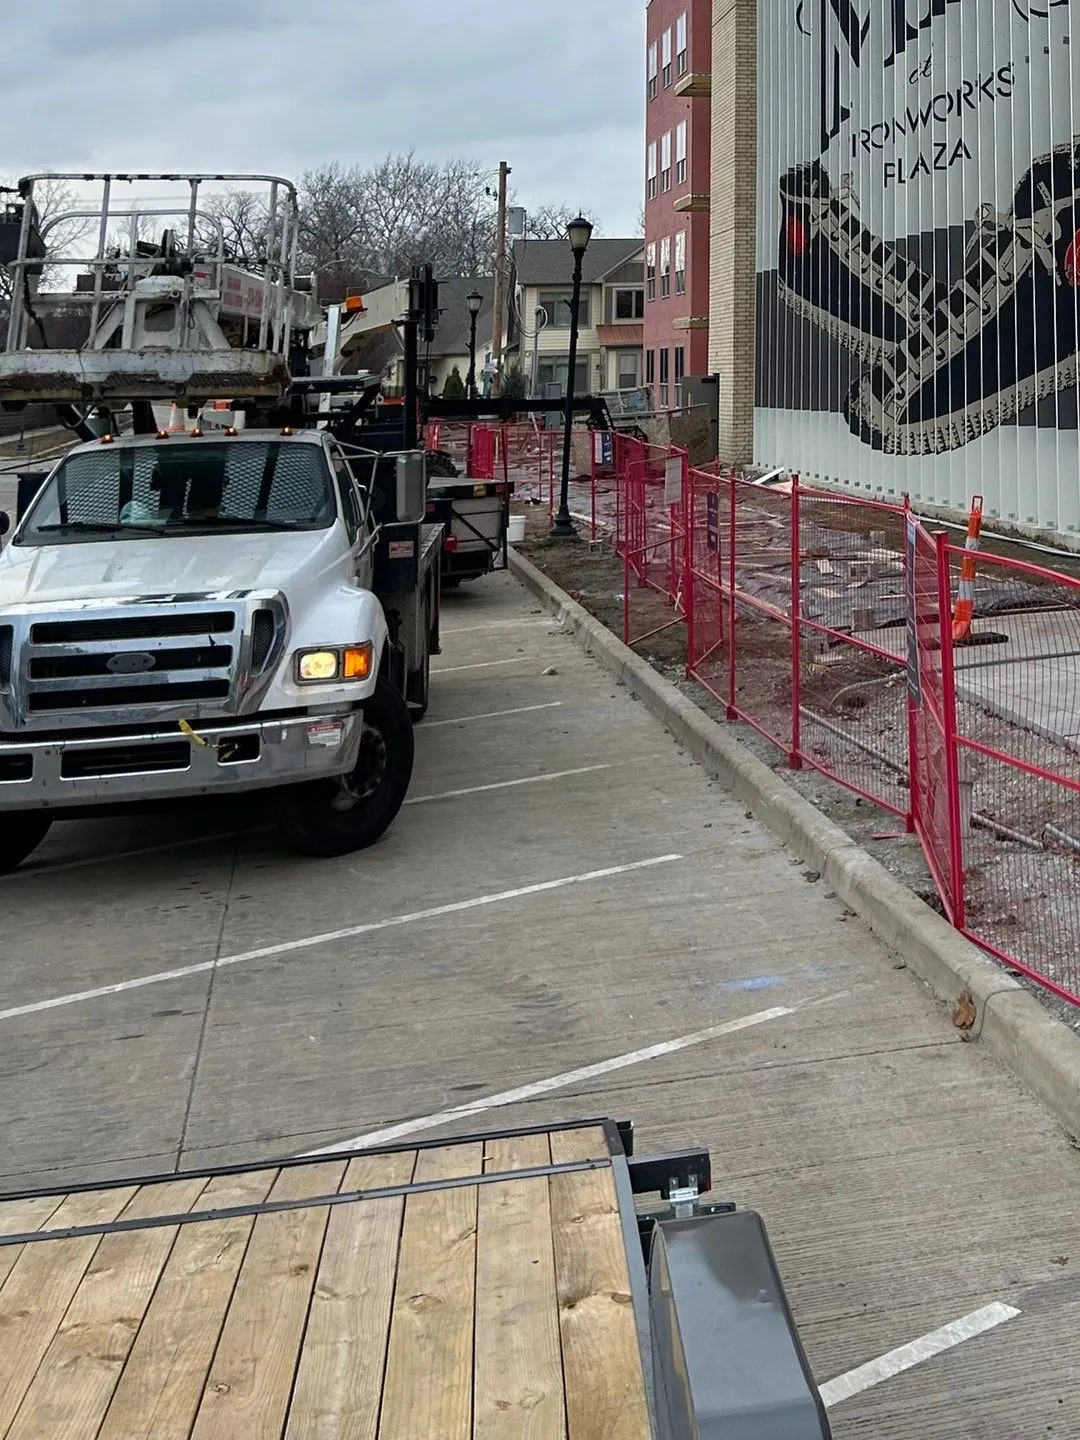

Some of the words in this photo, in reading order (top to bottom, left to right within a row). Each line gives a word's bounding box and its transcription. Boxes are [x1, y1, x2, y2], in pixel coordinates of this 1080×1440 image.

[908, 53, 932, 84] at
[851, 62, 1015, 158] IRONWORKS
[884, 137, 972, 188] PLAZA
